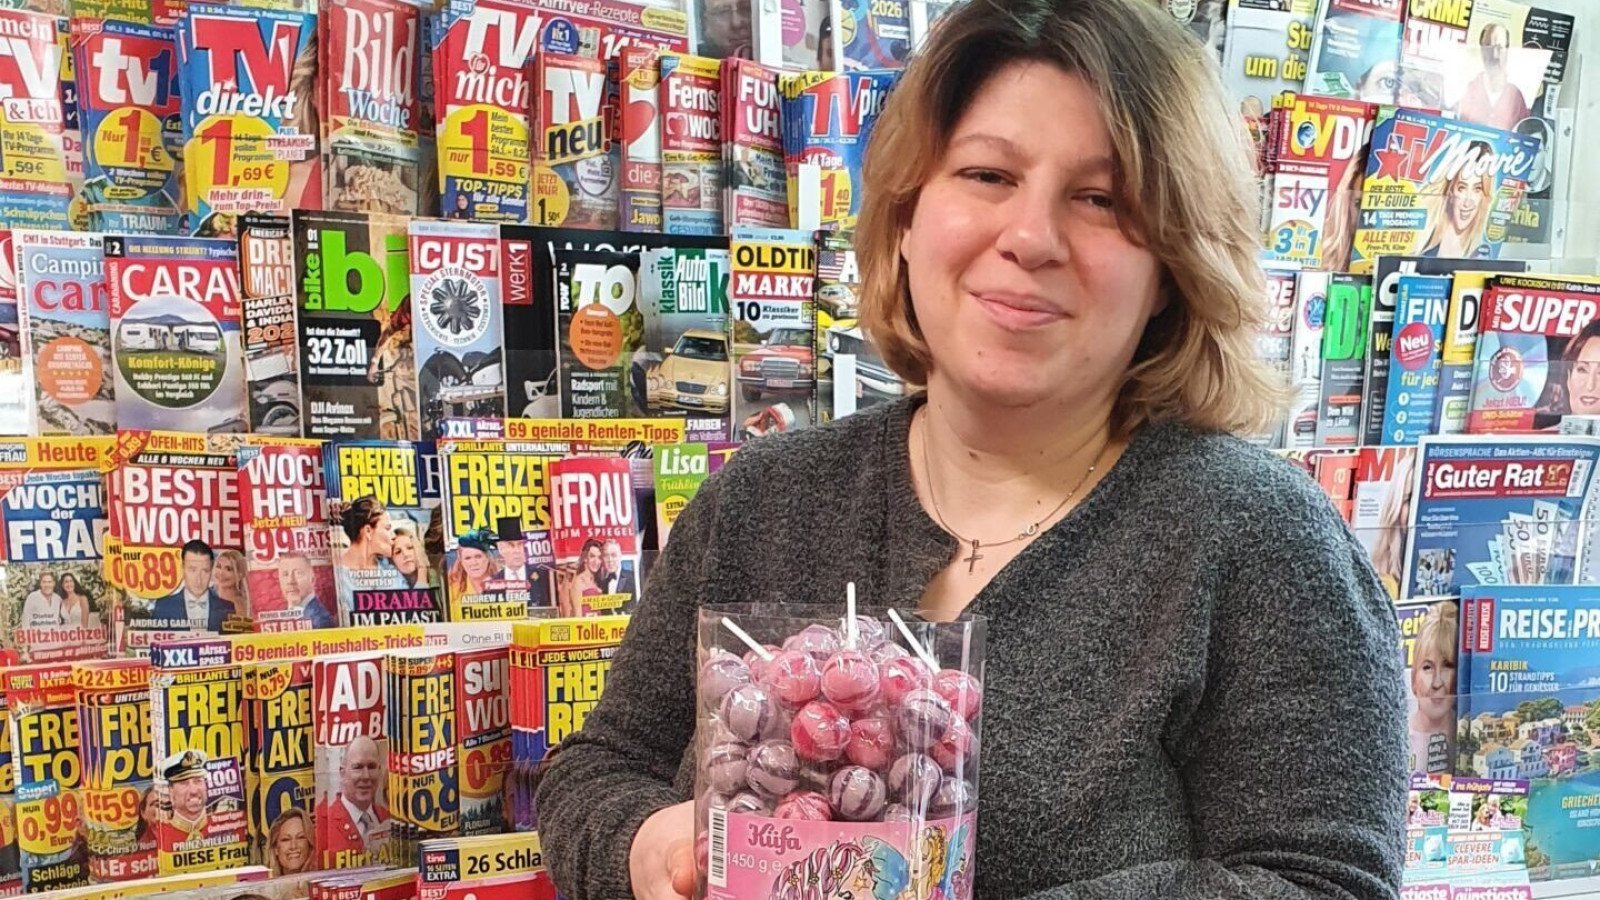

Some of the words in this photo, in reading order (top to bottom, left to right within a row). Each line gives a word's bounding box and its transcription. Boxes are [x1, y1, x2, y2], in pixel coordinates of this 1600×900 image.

[871, 1, 902, 17] 2026
[459, 6, 543, 69] TV
[190, 15, 302, 97] TV
[339, 7, 416, 106] Bild
[1244, 54, 1278, 79] um
[1282, 53, 1307, 82] die
[455, 65, 529, 109] mich
[546, 67, 606, 124] TV
[197, 82, 298, 119] direkt
[346, 87, 410, 129] Woche
[804, 75, 872, 137] TV
[1393, 119, 1449, 183] TV
[1418, 131, 1533, 184] Movie
[820, 155, 843, 171] Tage
[628, 165, 652, 184] die
[210, 189, 237, 201] Mehr
[455, 179, 523, 197] TOP-TIPPS
[1278, 179, 1326, 218] sky
[1367, 194, 1417, 208] TV-GUIDE
[1362, 212, 1377, 226] 14
[1274, 227, 1294, 254] 3
[1308, 229, 1319, 256] 1
[1362, 231, 1388, 244] ALLE
[1389, 231, 1414, 243] HITS!
[508, 242, 529, 301] werk1
[676, 254, 708, 282] Auto
[304, 252, 322, 311] bike
[657, 255, 676, 314] klassik
[678, 280, 707, 312] Bild
[737, 301, 762, 322] 10
[308, 338, 333, 365] 32
[335, 339, 368, 365] Zoll
[1400, 335, 1429, 352] Neu
[128, 356, 216, 372] Komfort-Könige
[571, 378, 604, 392] Radsport
[1401, 371, 1419, 388] für
[571, 392, 600, 405] Kindern
[446, 419, 475, 438] XXL
[508, 422, 527, 438] 69
[531, 422, 583, 441] geniale
[588, 423, 679, 441] Renten-Tipps
[37, 442, 97, 462] Heute
[150, 434, 205, 452] OFEN-HITS
[170, 455, 205, 466] WOCHEN
[207, 456, 225, 467] NEU
[338, 446, 416, 476] FREIZEIT
[659, 448, 707, 476] Lisa
[1434, 462, 1502, 490] Guter
[1503, 462, 1545, 489] Rat
[123, 466, 240, 509] BESTE
[51, 507, 76, 520] der
[125, 505, 242, 547] WOCHE
[587, 526, 634, 538] SPIEGEL
[252, 527, 295, 562] 99
[525, 540, 550, 556] 100
[123, 551, 142, 563] nur
[124, 550, 178, 592] 0,89
[1476, 565, 1498, 585] 100
[357, 591, 434, 611] DRAMA
[353, 612, 377, 627] IM
[380, 610, 440, 627] PALAST
[461, 604, 502, 620] Flucht
[505, 602, 525, 618] auf
[129, 618, 169, 629] ANDREAS
[576, 622, 608, 642] Tolle,
[1499, 608, 1568, 639] REISE
[163, 648, 198, 667] XXL
[234, 644, 255, 662] 69
[257, 642, 308, 661] geniale
[312, 634, 423, 658] Haushalts-Tricks
[542, 651, 566, 663] JEDE
[568, 648, 600, 661] WOCHE
[259, 666, 279, 680] NUR
[1490, 660, 1529, 672] KARIBIK
[177, 670, 230, 685] BRILLANTE
[1488, 671, 1509, 693] 10
[1510, 671, 1555, 682] STRANDTIPPS
[205, 768, 238, 789] 100
[412, 774, 435, 789] NUR
[17, 781, 57, 800] Super!
[22, 791, 79, 842] 0,99
[747, 823, 802, 856] Küfa
[109, 858, 127, 877] Er
[172, 850, 214, 868] DIESE
[425, 853, 446, 864] tina
[467, 856, 490, 875] 26
[31, 863, 81, 882] Schläge
[427, 870, 458, 882] EXTRA
